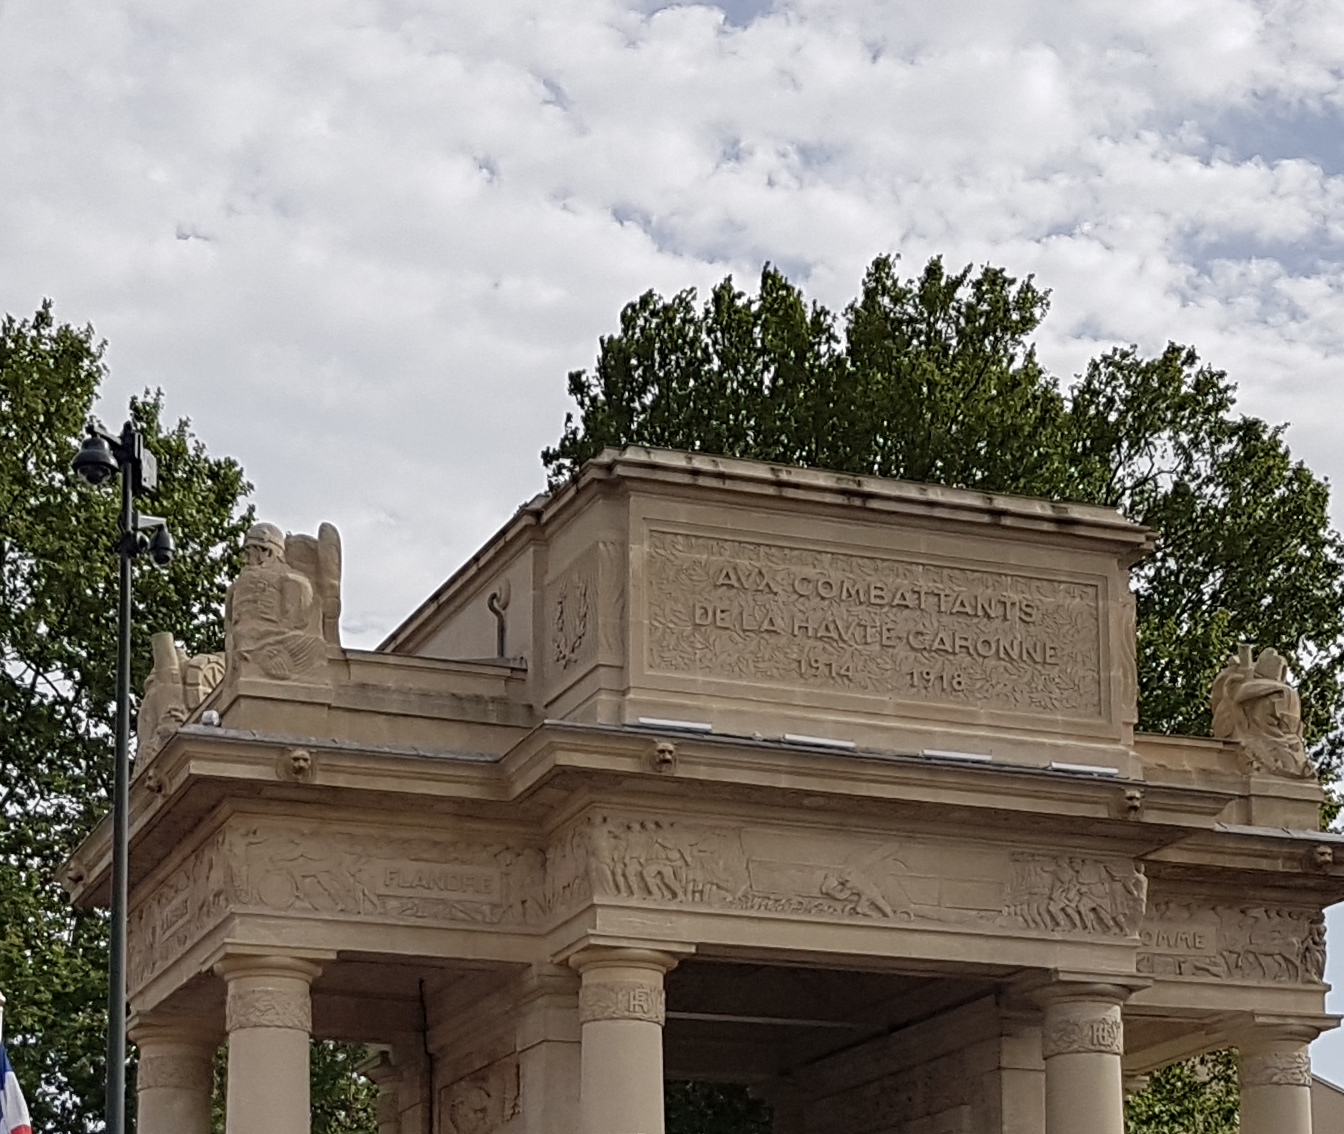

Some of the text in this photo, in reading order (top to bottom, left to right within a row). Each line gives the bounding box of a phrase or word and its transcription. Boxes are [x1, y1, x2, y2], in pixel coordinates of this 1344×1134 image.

[792, 575, 1040, 624] COMBATTANTS
[693, 603, 733, 630] DE
[740, 607, 782, 635] LA
[799, 658, 965, 692] 1914 1918
[383, 869, 494, 895] FLANDRE
[1138, 930, 1206, 950] OMME
